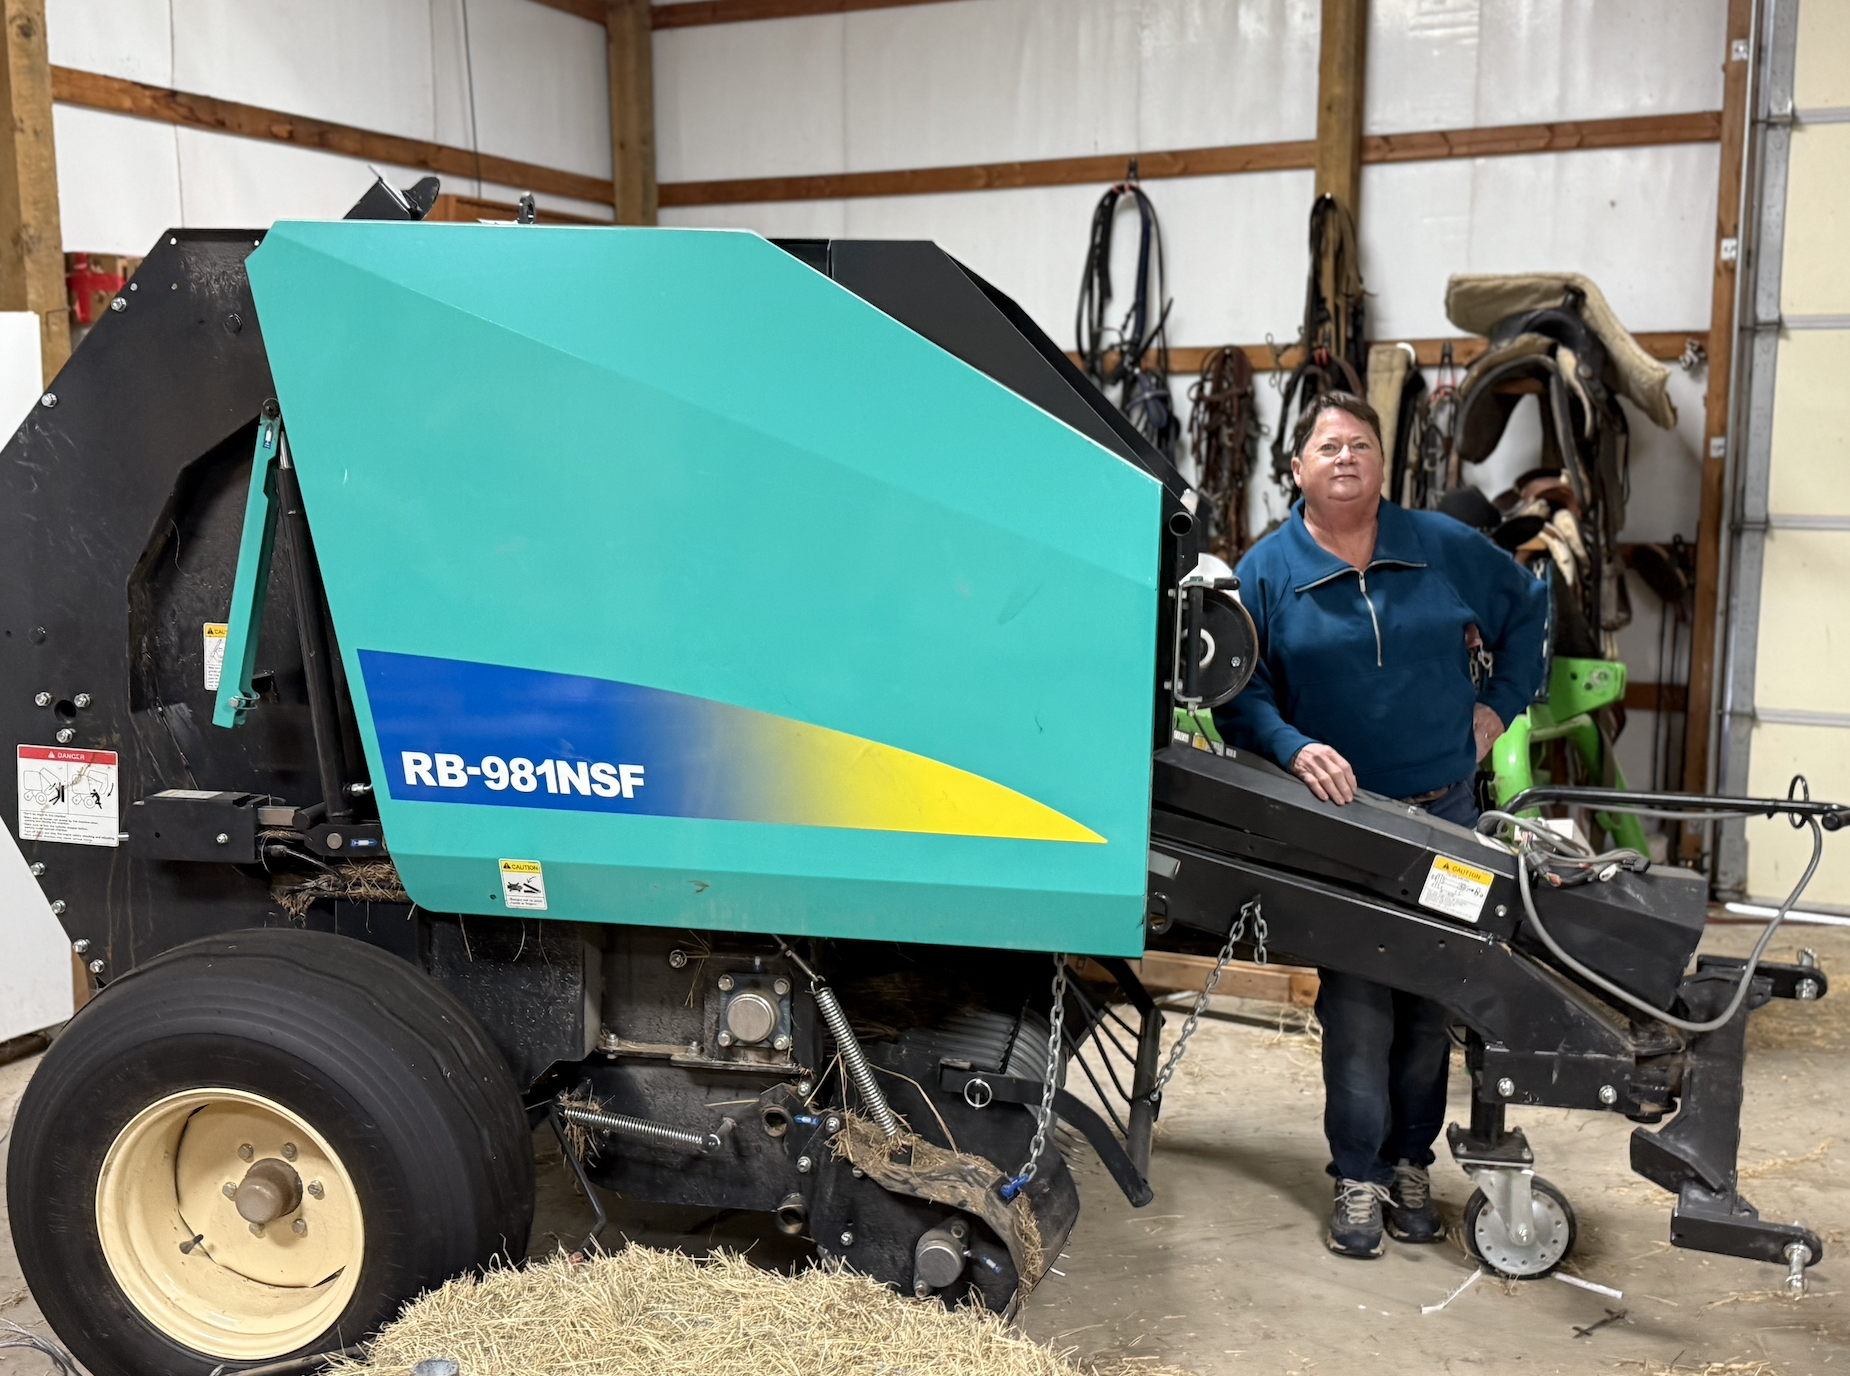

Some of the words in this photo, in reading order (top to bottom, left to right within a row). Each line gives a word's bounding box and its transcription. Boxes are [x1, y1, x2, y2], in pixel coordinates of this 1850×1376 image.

[57, 752, 85, 760] DANGER
[401, 751, 645, 799] RB-981NSF
[1452, 865, 1481, 881] CAUTION
